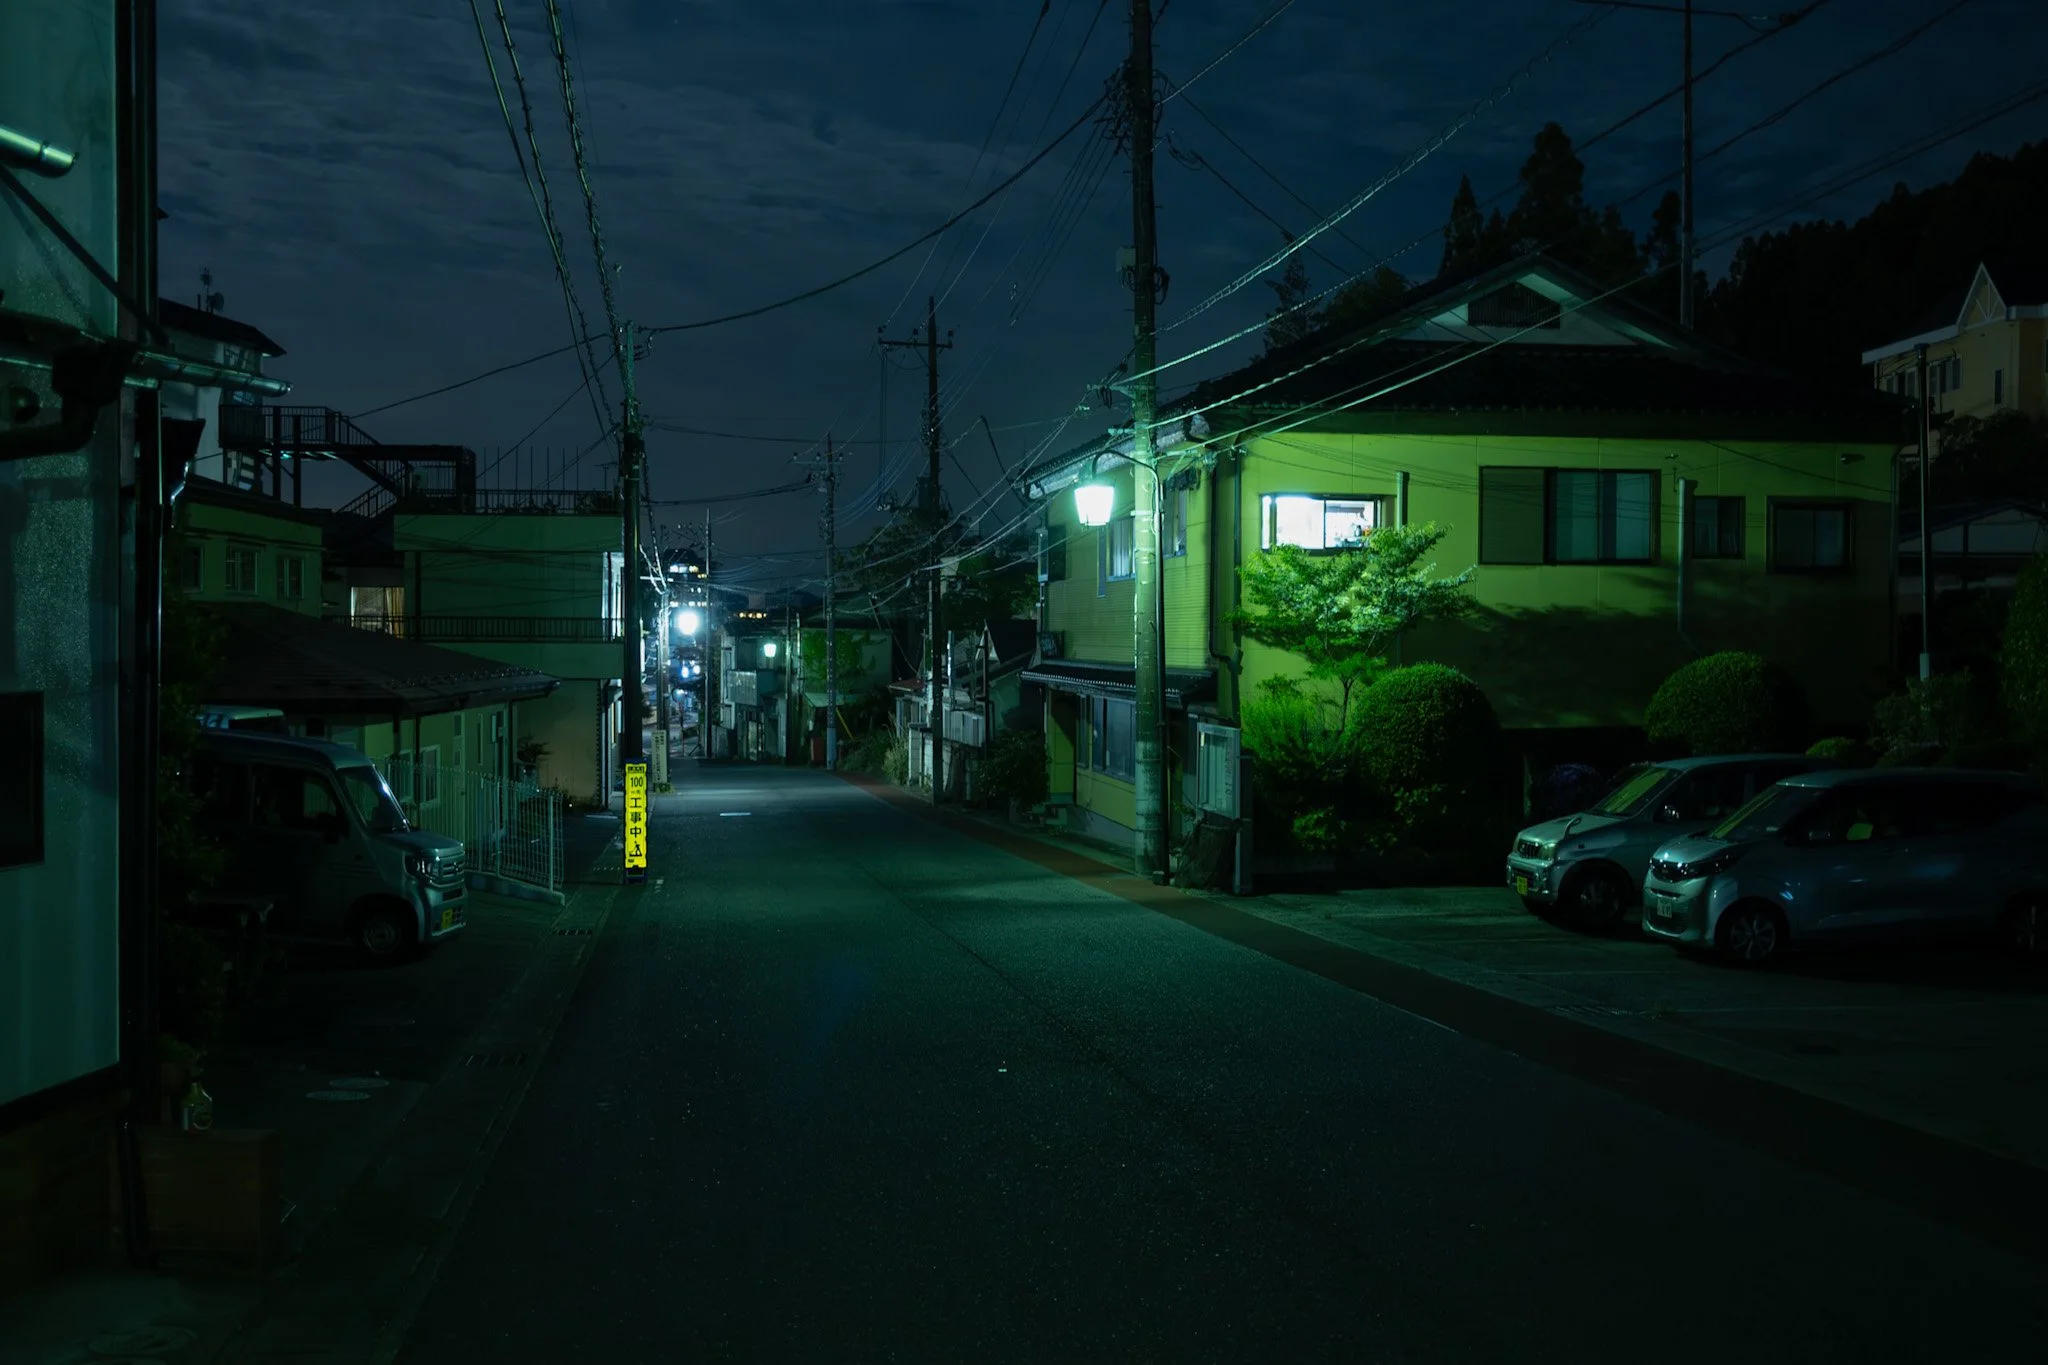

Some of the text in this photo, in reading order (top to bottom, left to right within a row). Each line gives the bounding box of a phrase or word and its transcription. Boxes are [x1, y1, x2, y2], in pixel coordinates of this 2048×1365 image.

[630, 776, 643, 787] 100
[630, 797, 642, 838] 工事中
